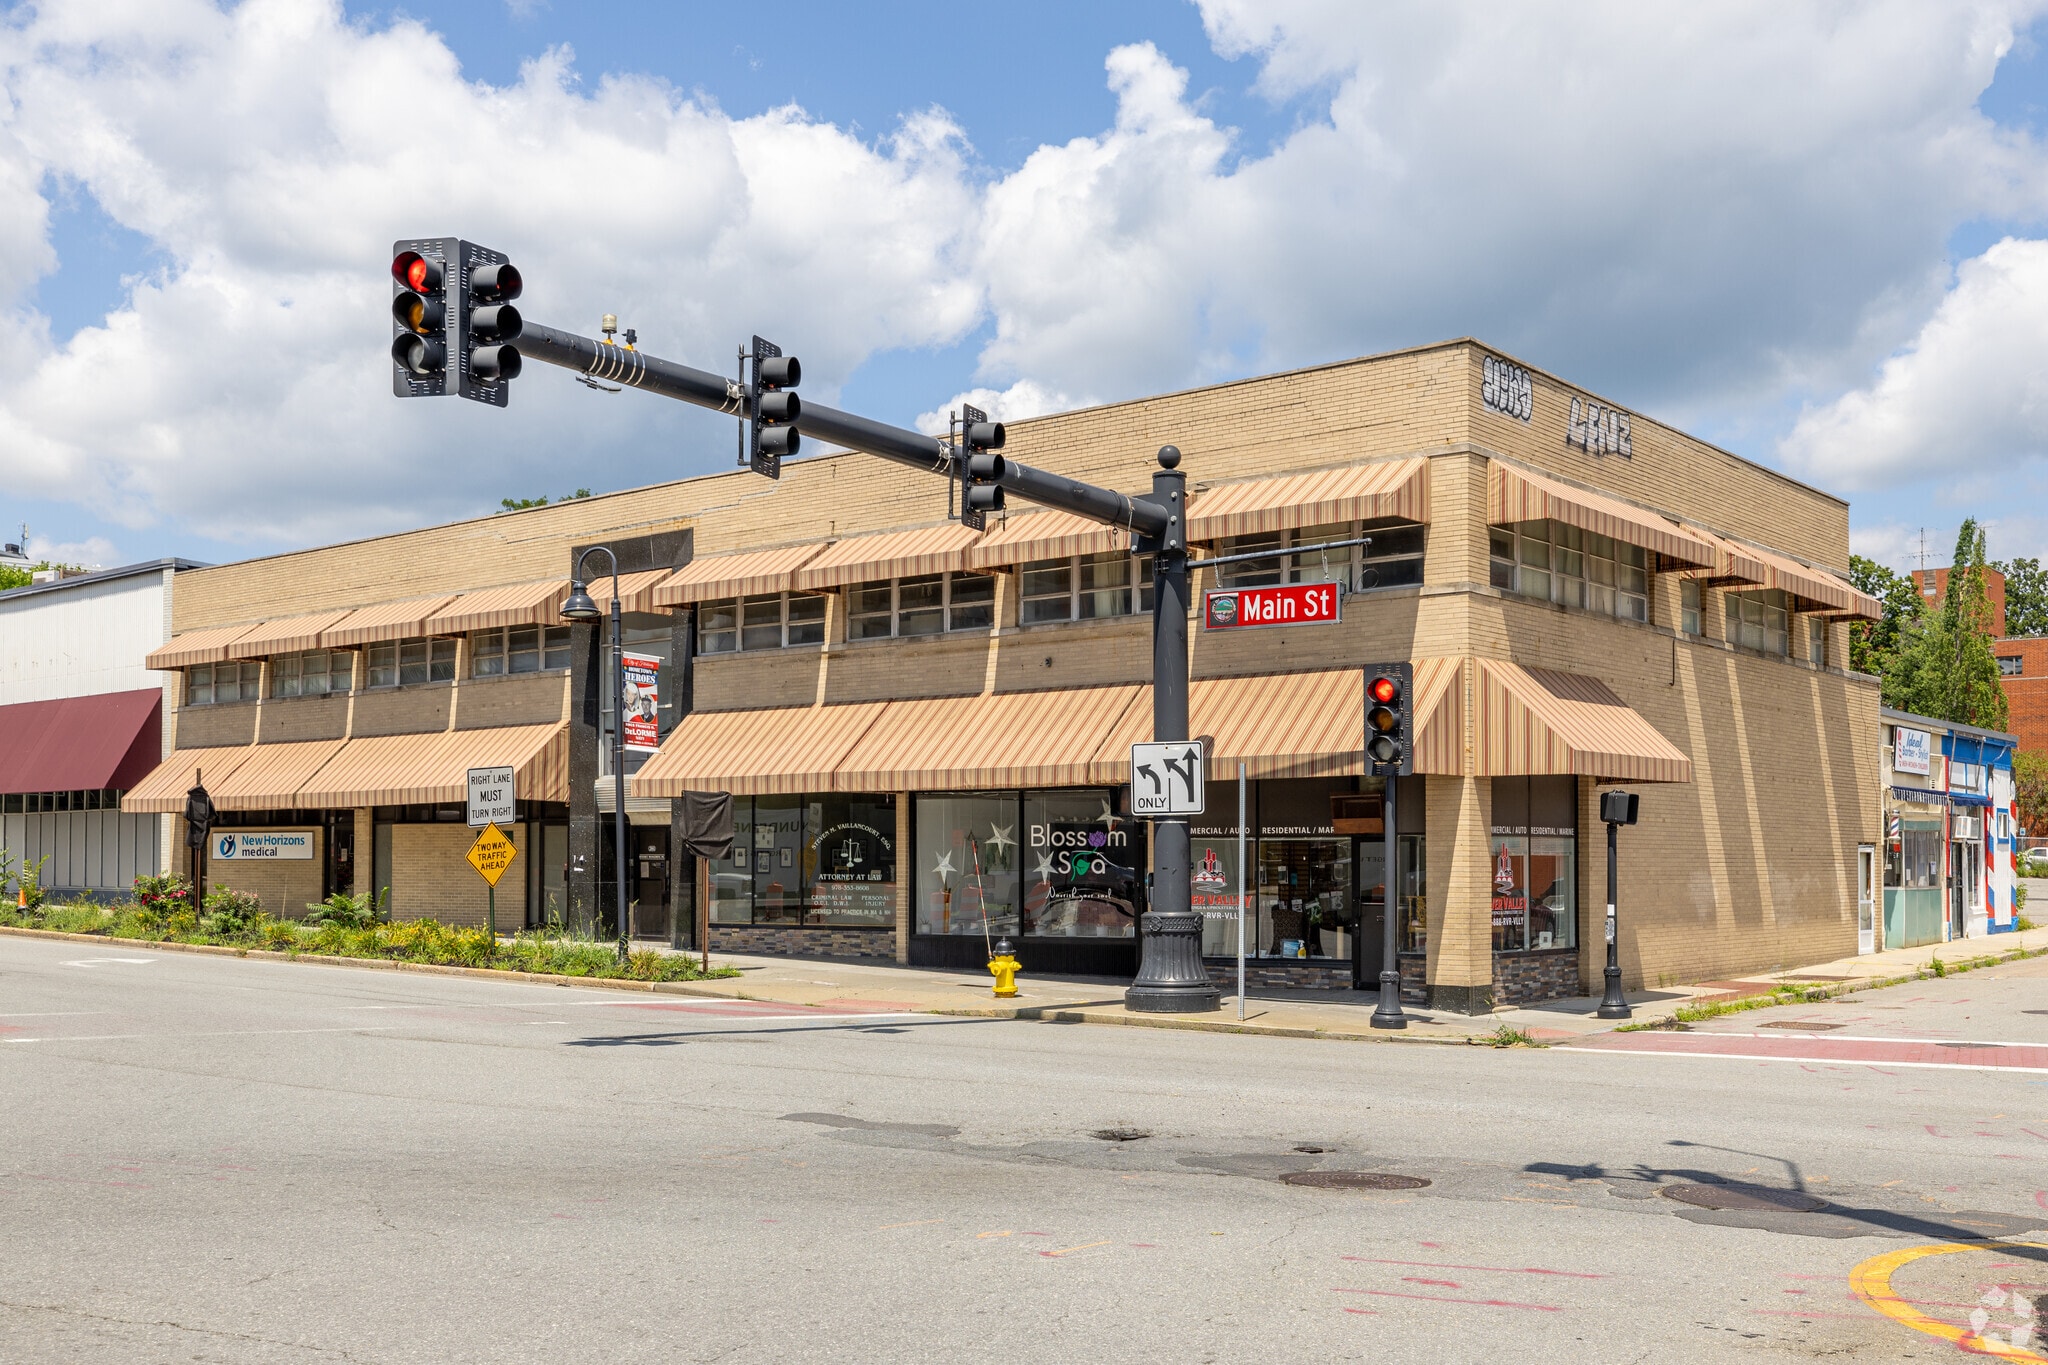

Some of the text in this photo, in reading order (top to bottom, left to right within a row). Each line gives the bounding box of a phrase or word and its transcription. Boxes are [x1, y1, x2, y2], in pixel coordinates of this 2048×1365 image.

[1244, 593, 1296, 621] Main
[1304, 590, 1330, 617] St
[625, 672, 656, 684] HEROES
[1907, 732, 1923, 748] Ideal
[471, 774, 510, 785] RIGHT LANE
[480, 790, 502, 802] MUST
[1138, 797, 1166, 808] ONLY
[472, 807, 511, 819] TURN RIGHT
[811, 831, 830, 850] STEVEN
[242, 847, 278, 856] medical
[478, 851, 507, 861] TRAFFIC
[481, 861, 505, 871] AHEAD
[1191, 895, 1253, 909] ER VALLY
[1503, 898, 1527, 912] VALLEY
